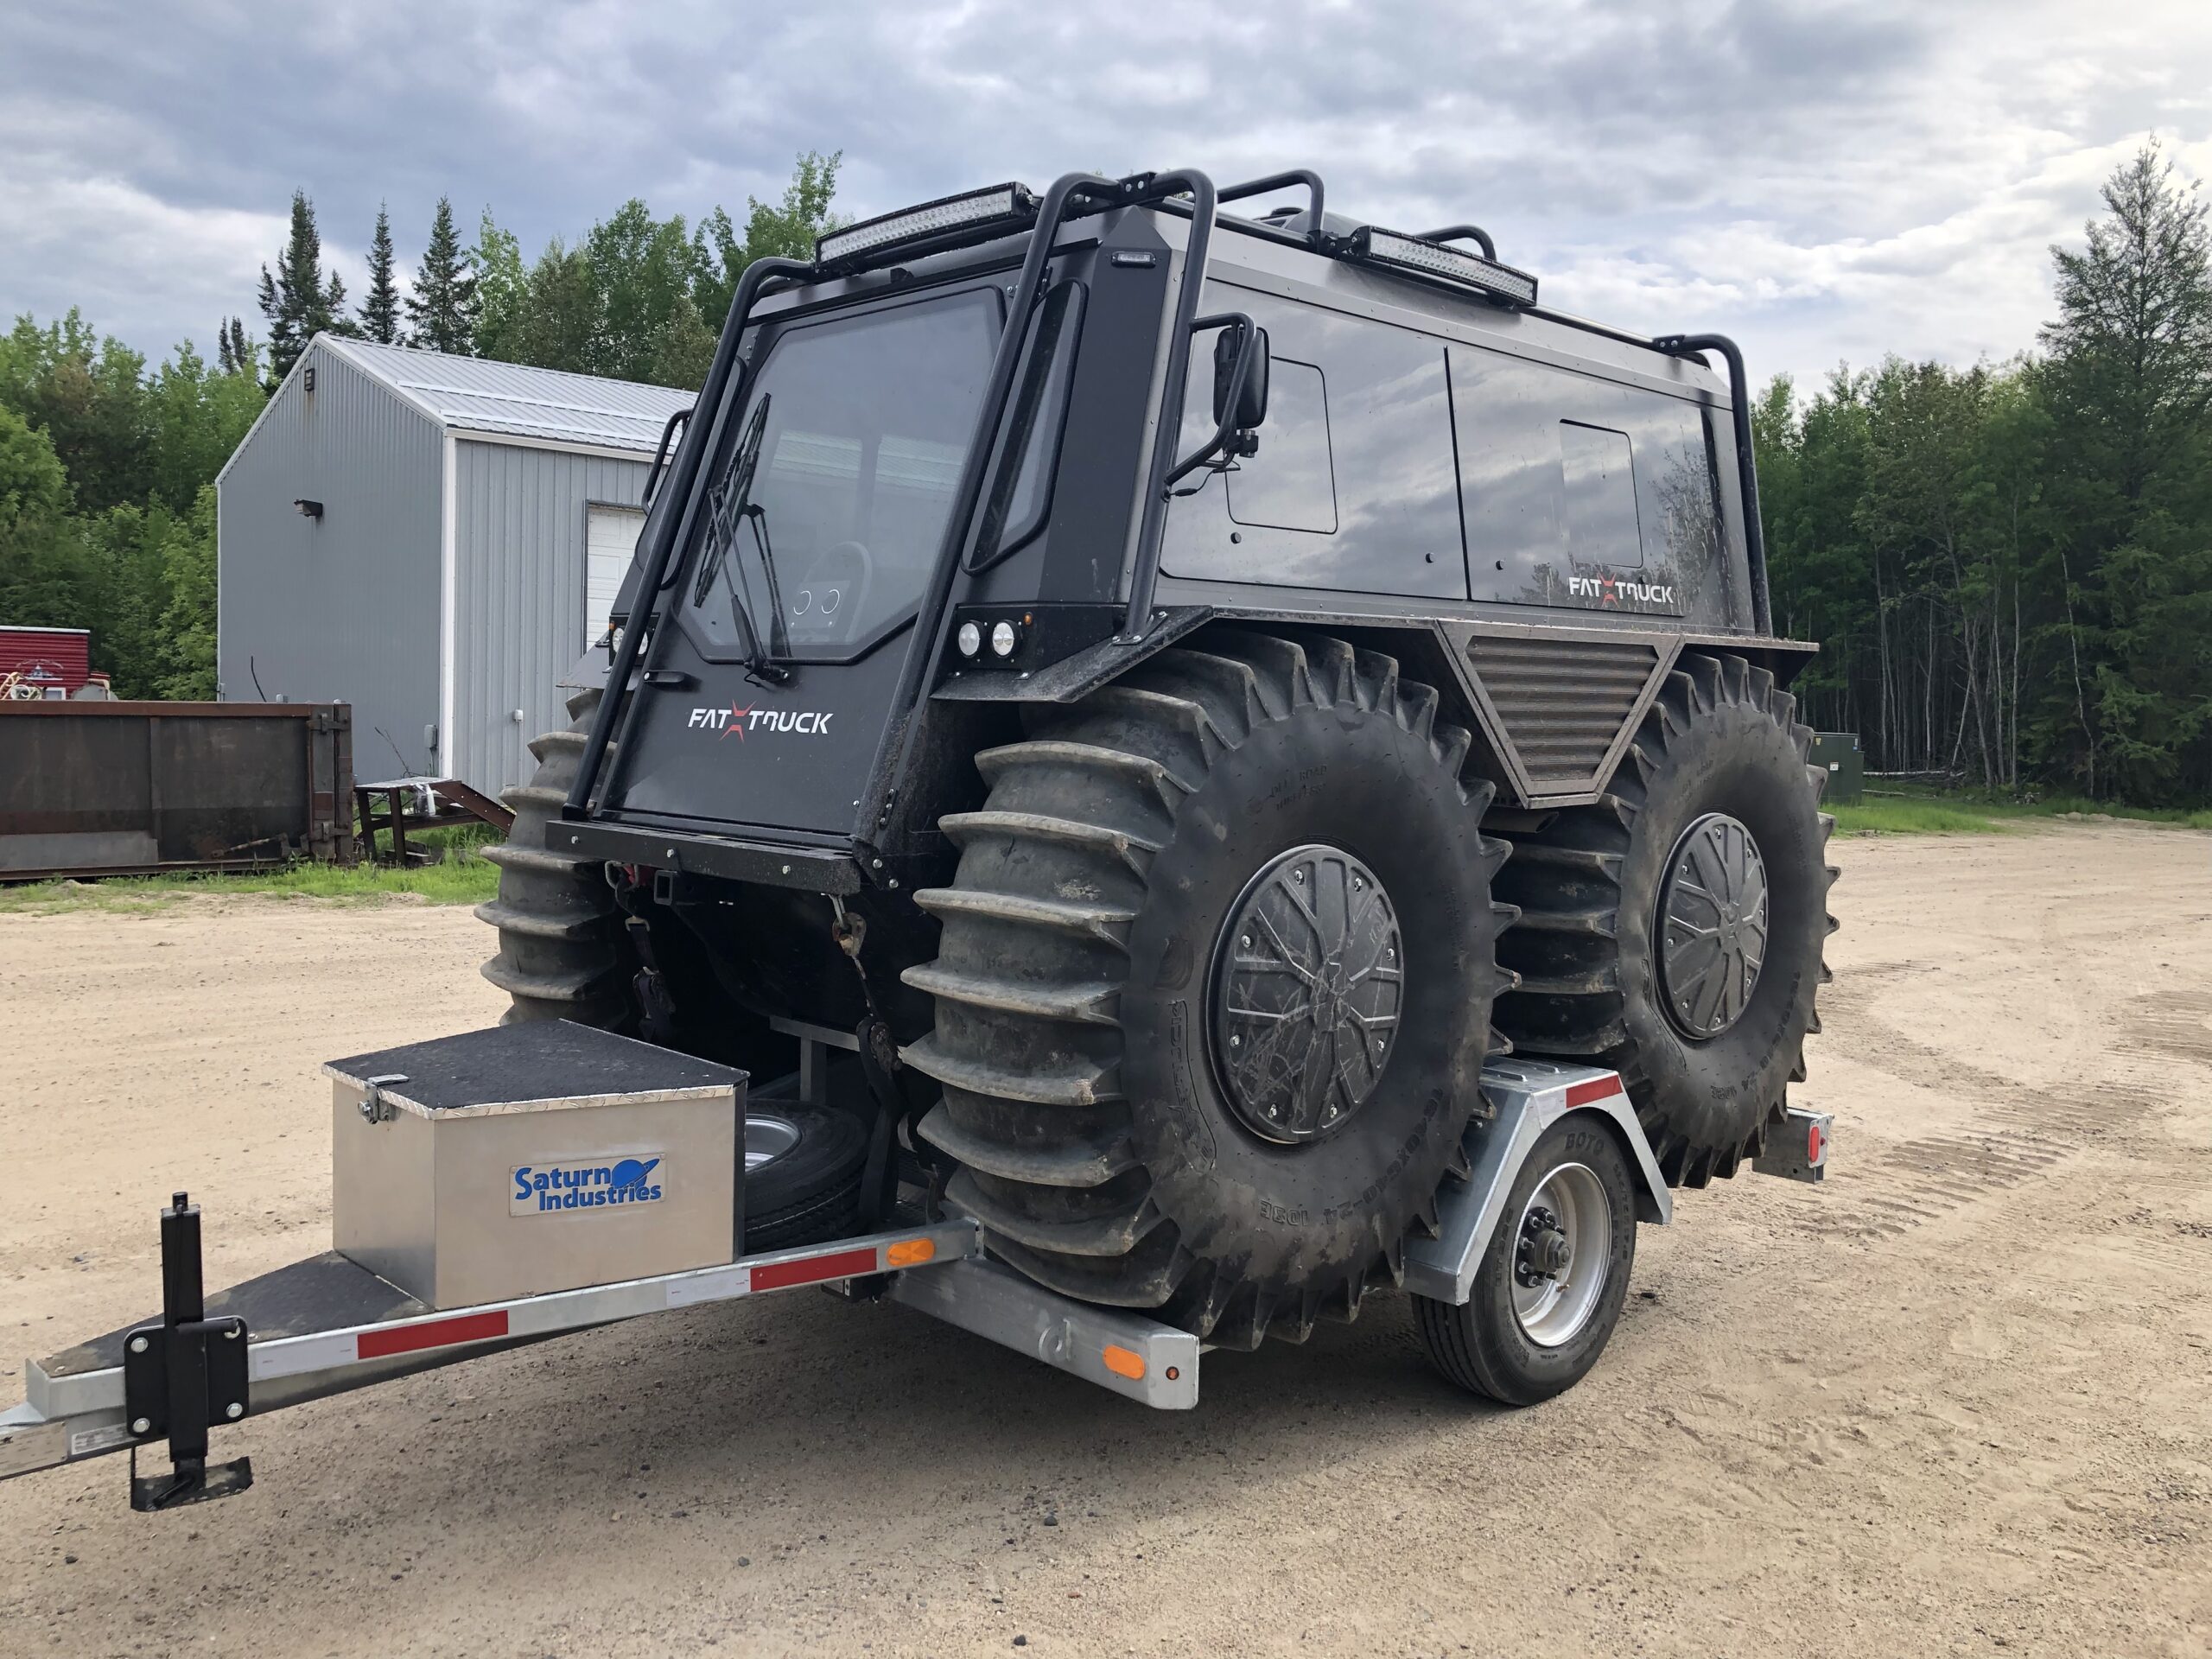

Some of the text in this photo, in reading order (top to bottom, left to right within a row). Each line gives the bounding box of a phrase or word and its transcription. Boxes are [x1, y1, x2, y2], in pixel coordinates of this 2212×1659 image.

[1568, 576, 1674, 604] FAT TRUCK
[688, 709, 834, 734] FAT TRUCK
[1565, 1131, 1605, 1156] BOTO
[514, 1166, 611, 1200] Saturn
[539, 1182, 662, 1211] Industries
